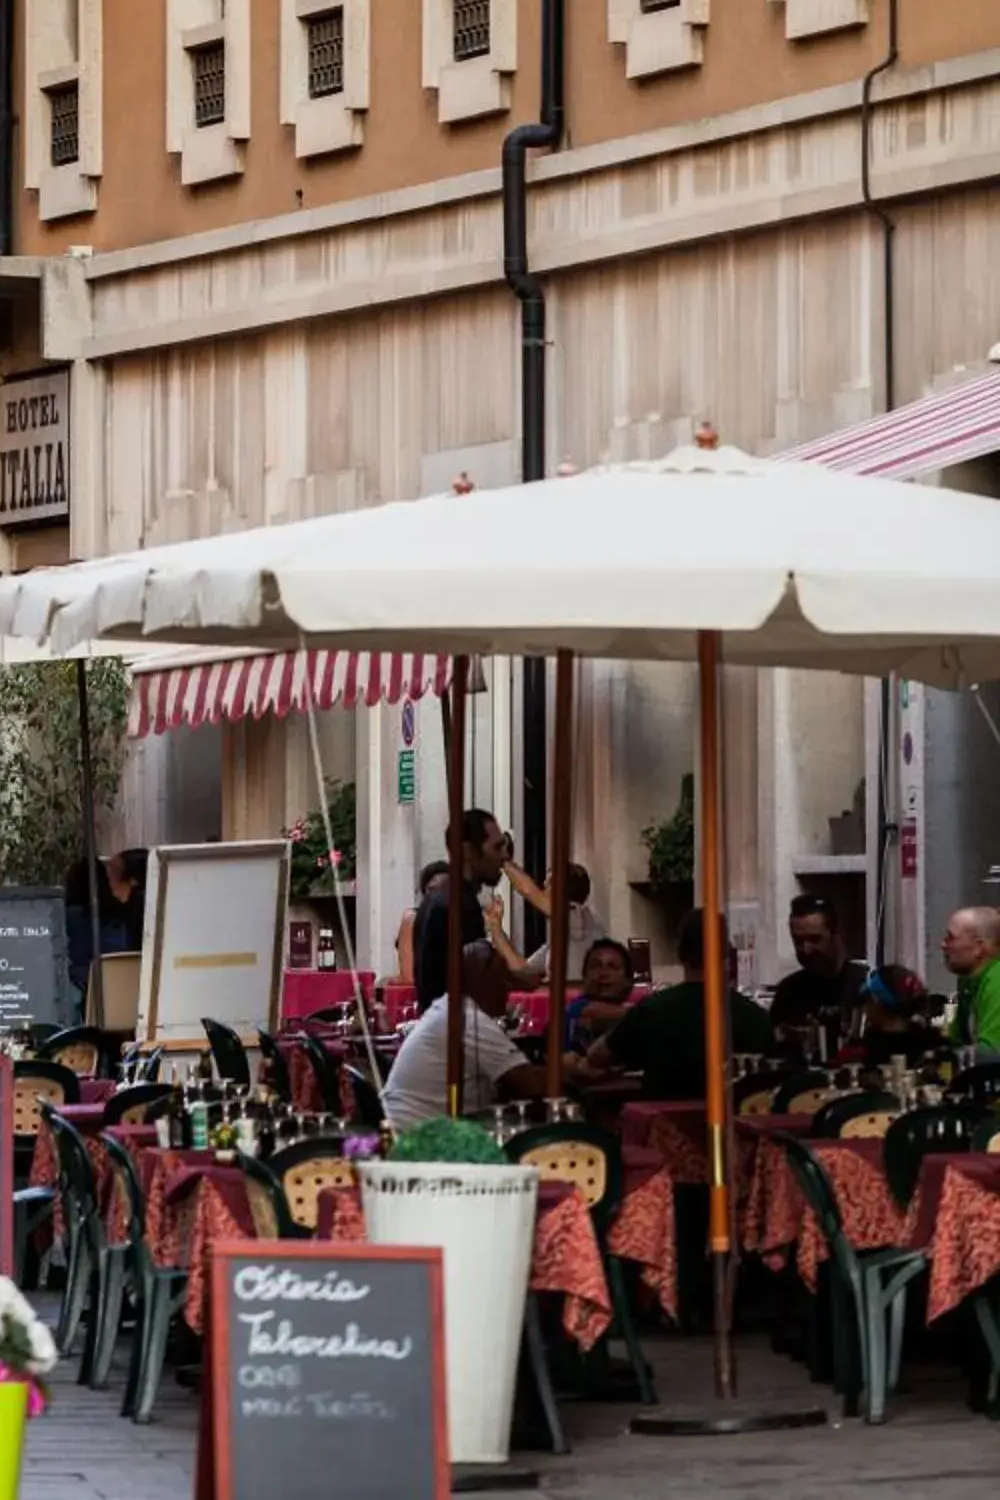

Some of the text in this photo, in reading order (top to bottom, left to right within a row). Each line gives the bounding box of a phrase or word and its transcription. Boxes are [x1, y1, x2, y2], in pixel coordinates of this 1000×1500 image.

[5, 393, 60, 434] HOTEL
[0, 441, 67, 513] ITALIA
[234, 1264, 371, 1302] Osteria
